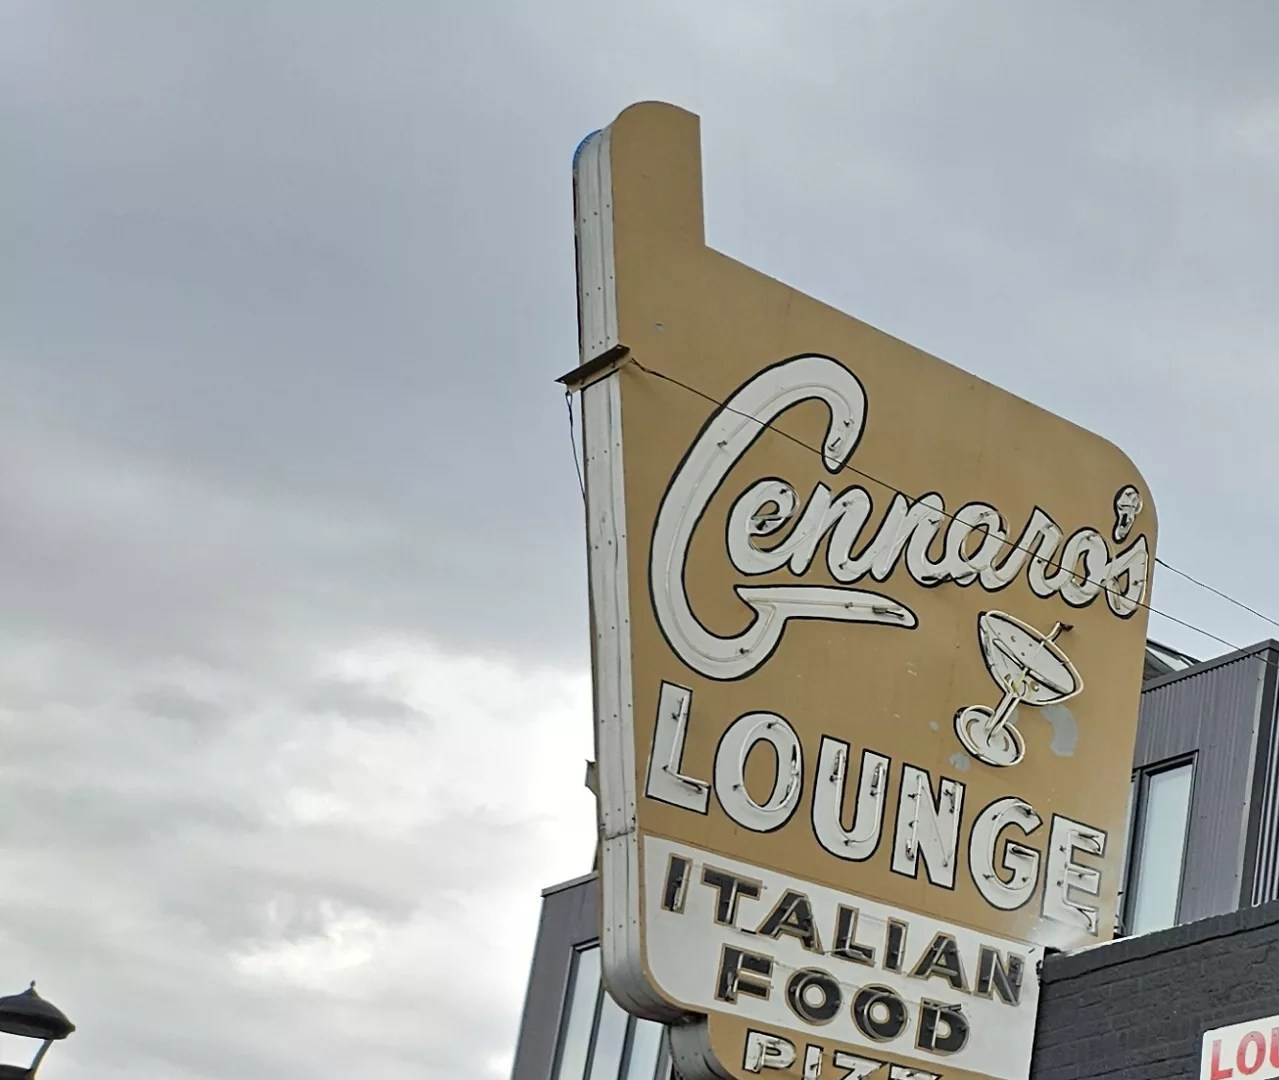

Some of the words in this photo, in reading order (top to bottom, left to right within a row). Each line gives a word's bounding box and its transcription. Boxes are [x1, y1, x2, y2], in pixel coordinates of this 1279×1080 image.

[644, 680, 1109, 937] LOUNGE
[660, 852, 1025, 1007] ITALIAN
[715, 943, 971, 1056] FOOD
